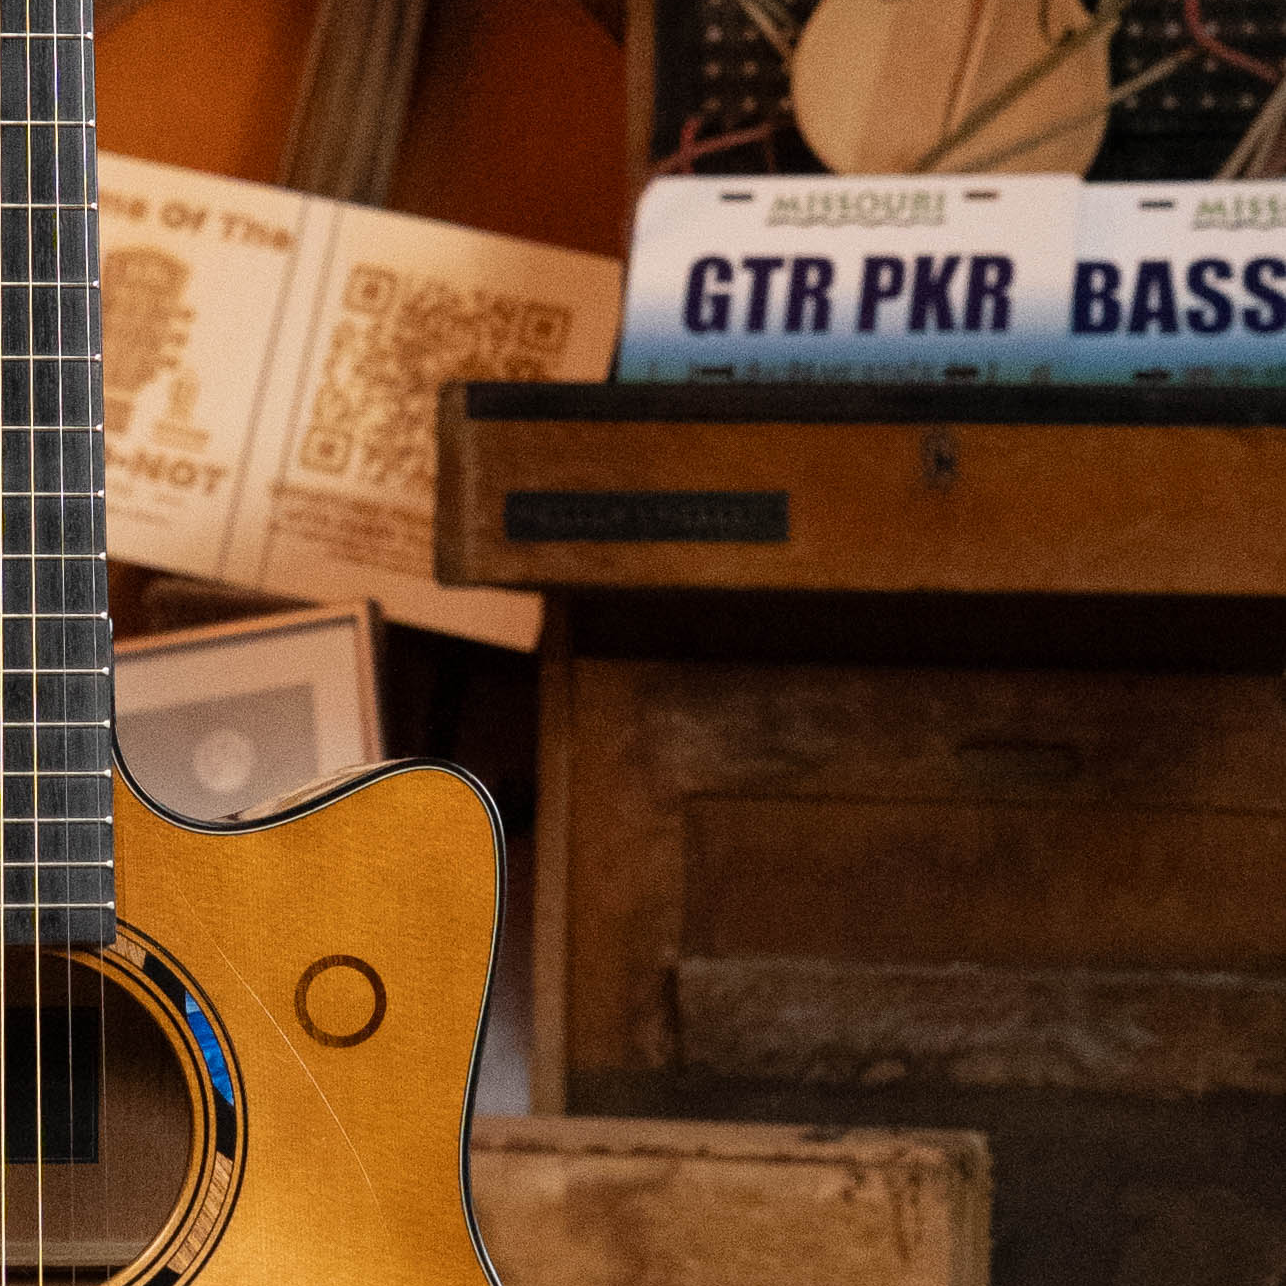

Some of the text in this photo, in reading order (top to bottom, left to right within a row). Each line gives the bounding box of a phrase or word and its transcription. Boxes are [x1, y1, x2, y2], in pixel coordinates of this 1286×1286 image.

[771, 190, 948, 216] MISSOURI
[1196, 195, 1286, 220] MISS
[682, 254, 1015, 335] GTR PKR
